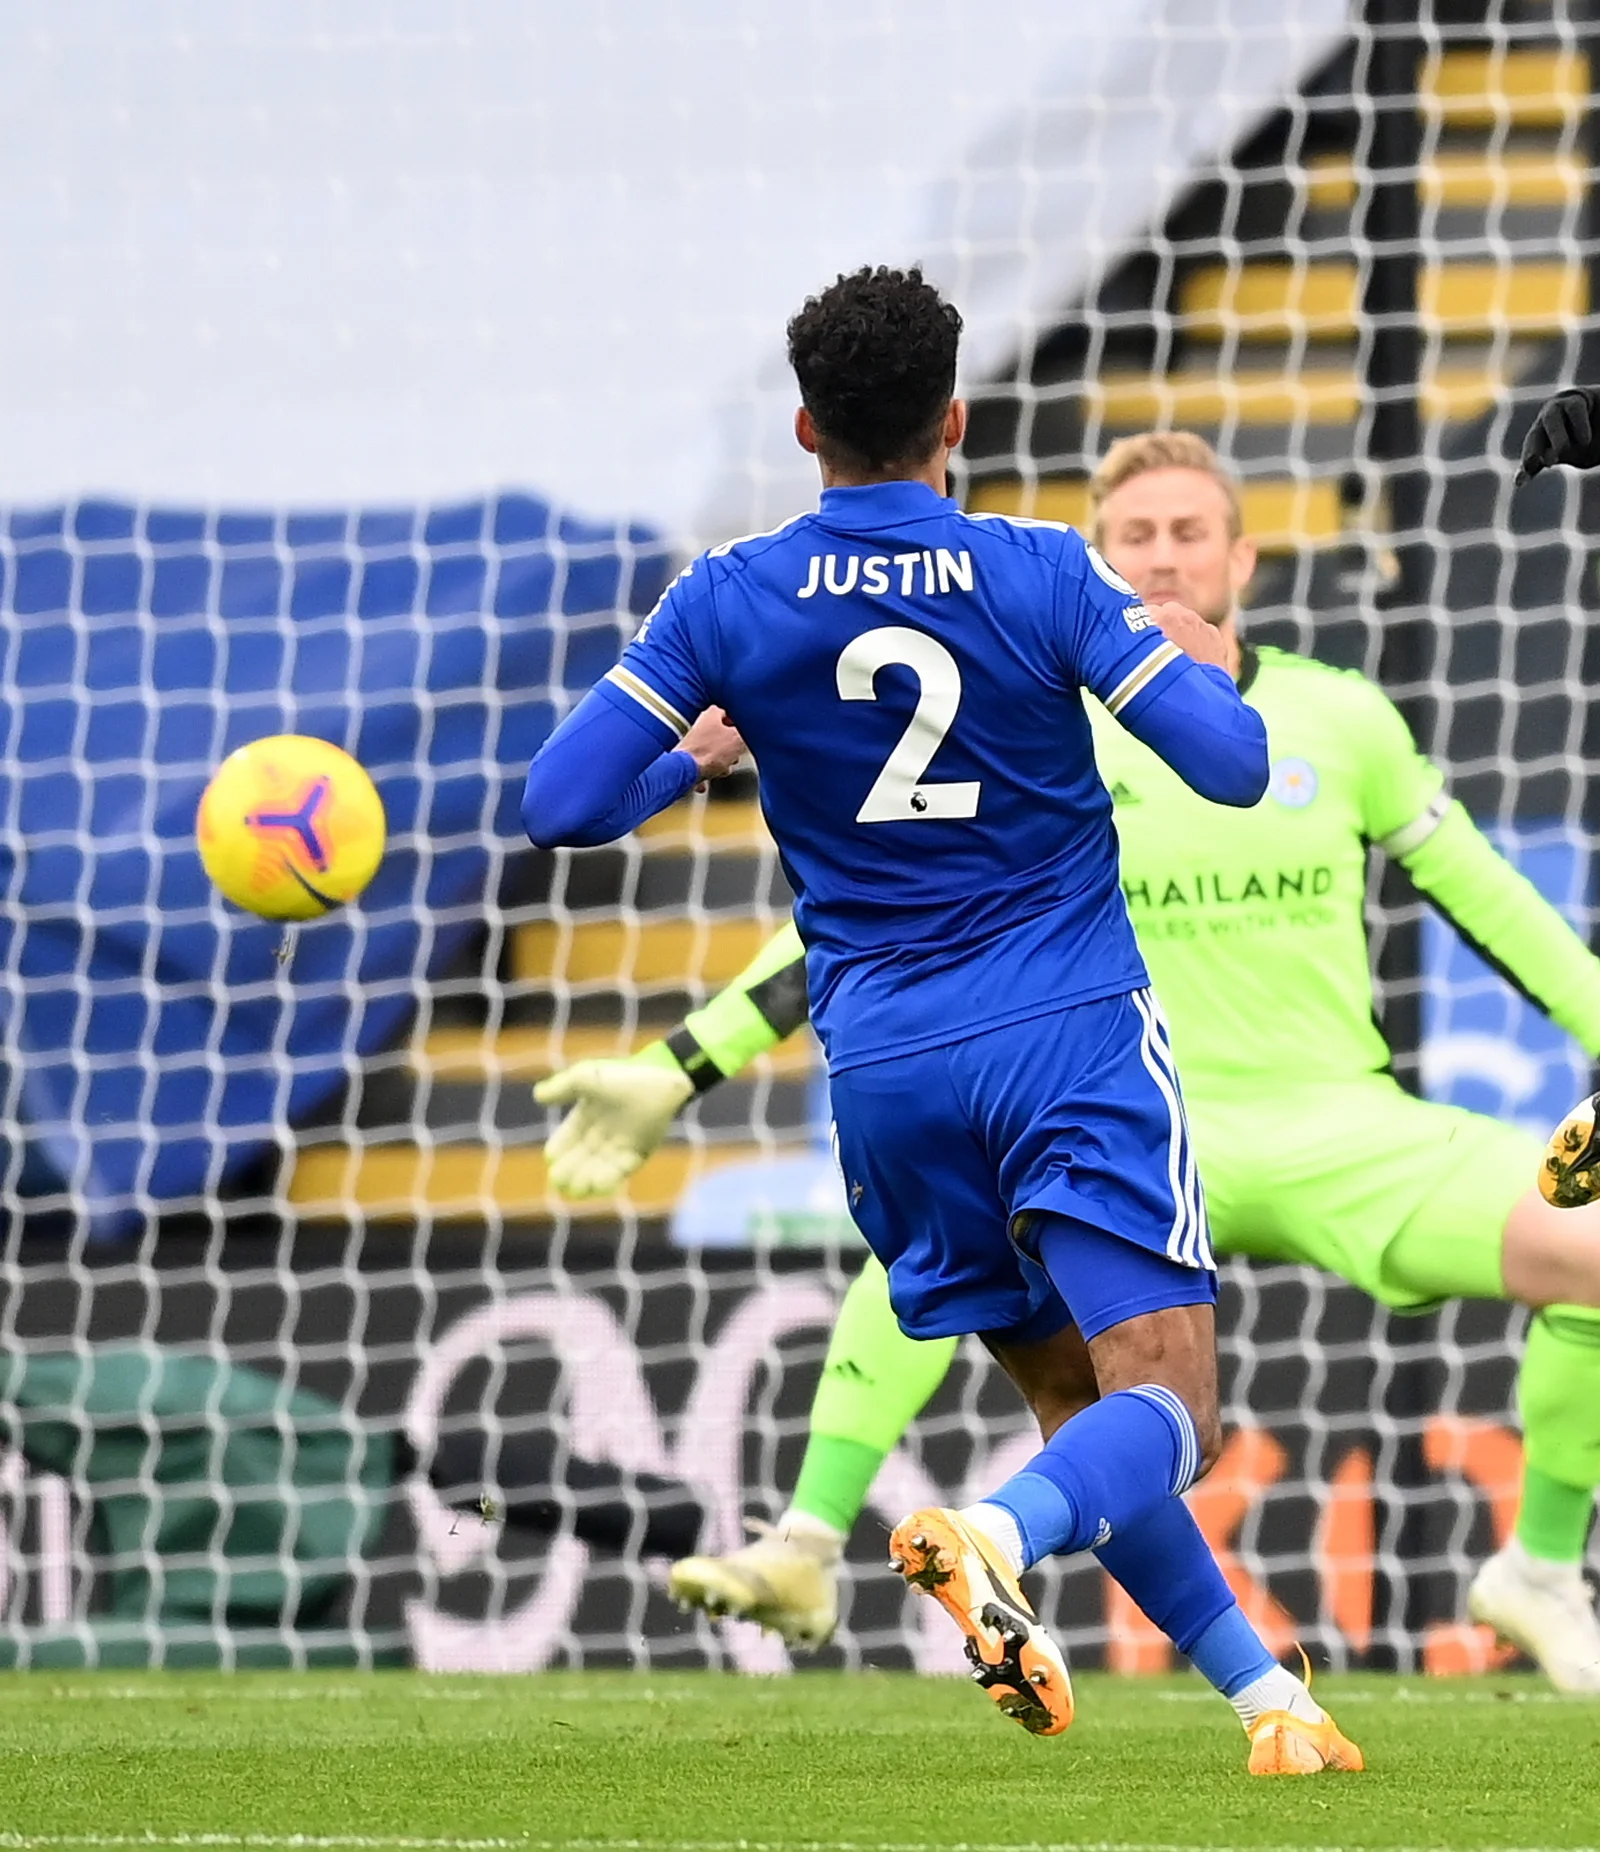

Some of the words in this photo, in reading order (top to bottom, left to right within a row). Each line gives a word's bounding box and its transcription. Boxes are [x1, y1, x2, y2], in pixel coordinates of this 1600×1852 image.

[797, 548, 975, 599] JUSTIN
[836, 626, 982, 823] 2
[1120, 868, 1333, 908] HAILAND
